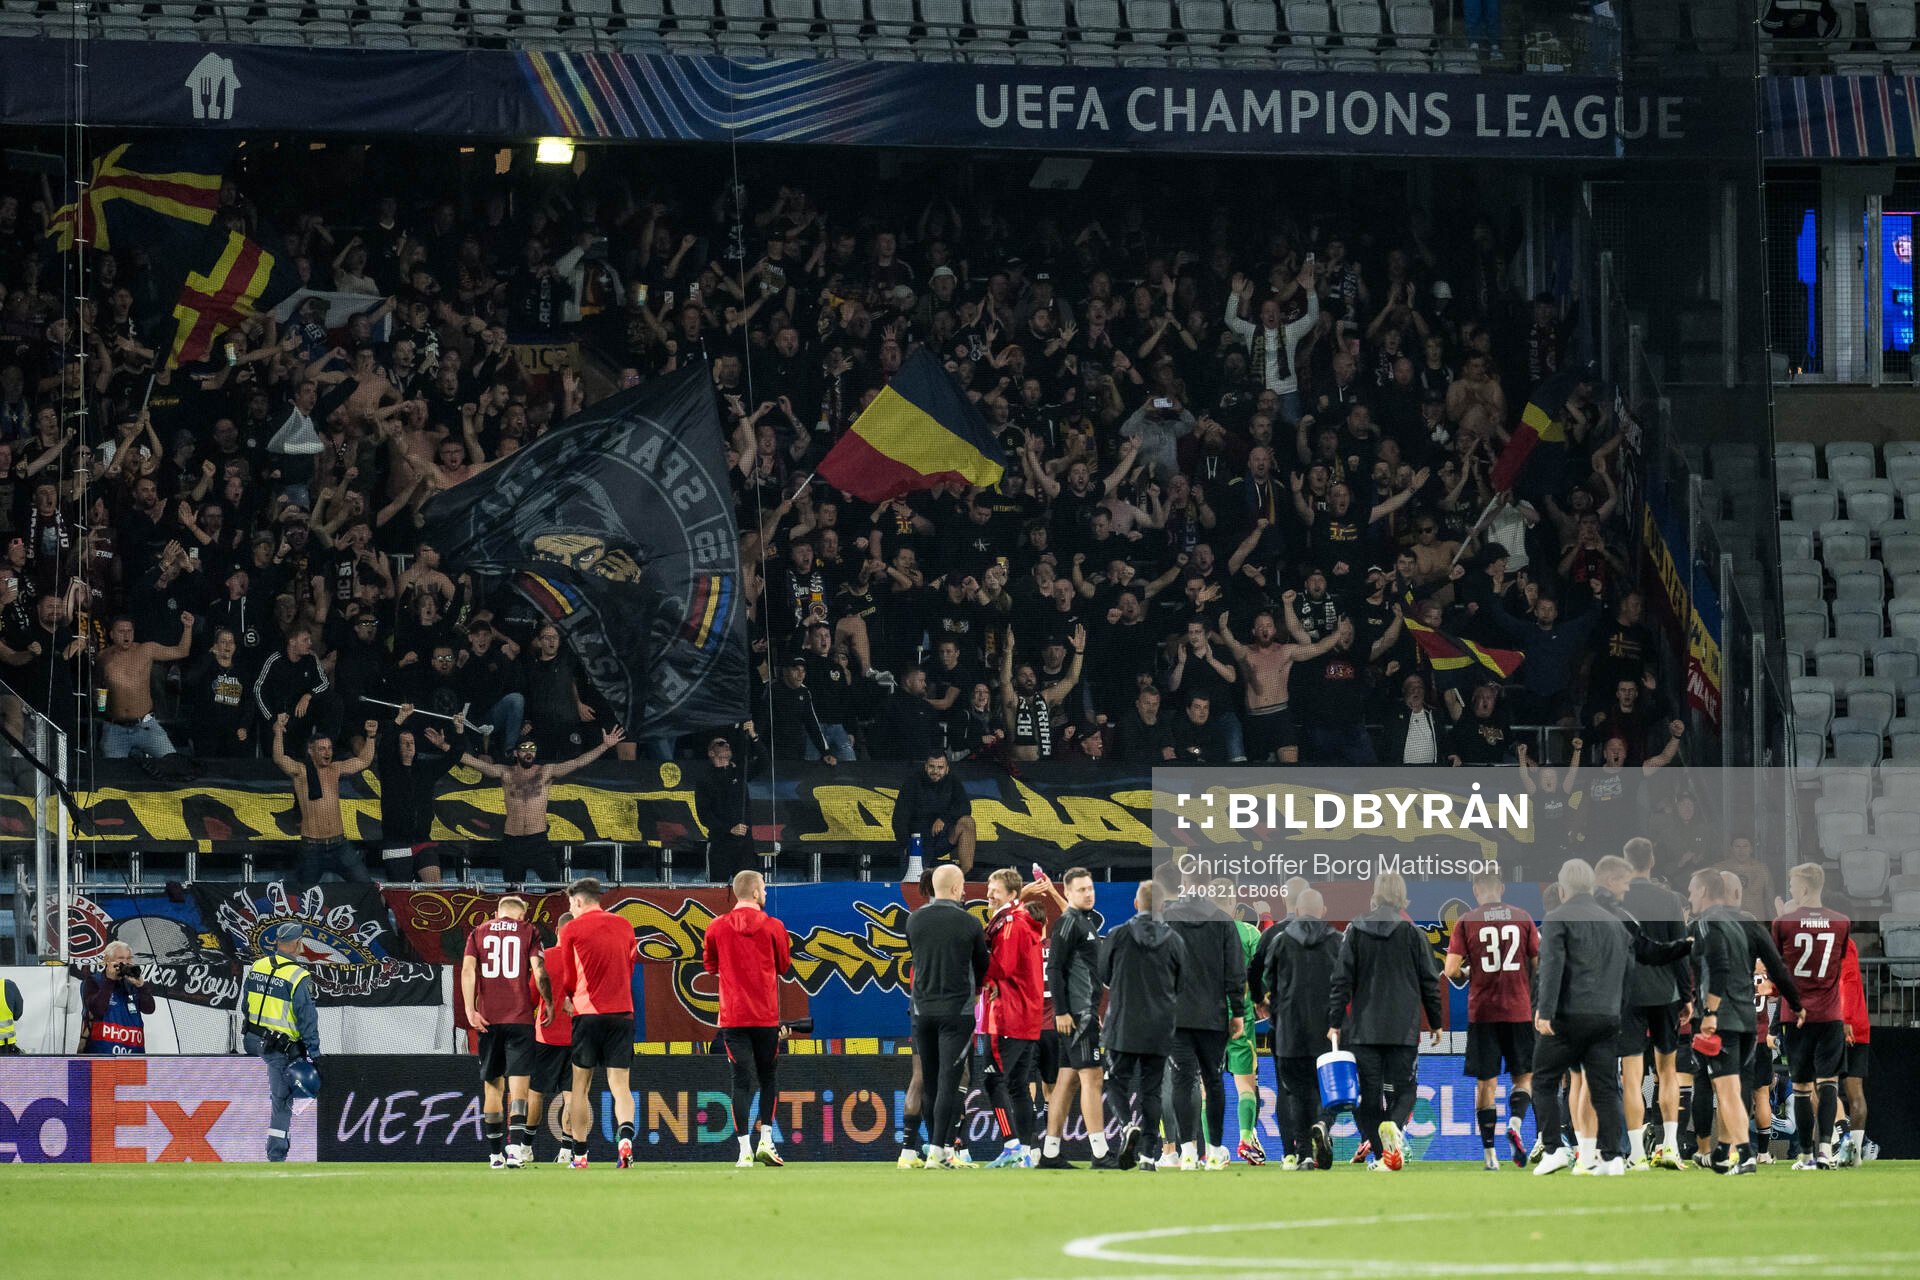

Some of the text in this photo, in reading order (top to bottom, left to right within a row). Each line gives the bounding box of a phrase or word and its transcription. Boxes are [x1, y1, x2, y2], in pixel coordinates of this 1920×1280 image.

[976, 84, 1687, 140] UEFA CHAMPIONS LEAGUE
[482, 936, 520, 979] 30
[1479, 924, 1520, 972] 32
[1794, 932, 1835, 978] 27
[184, 963, 239, 1006] Boys
[250, 972, 285, 987] ORDNNGS
[256, 983, 274, 995] VAT
[102, 1024, 142, 1044] PHOTO
[0, 1060, 232, 1163] dEx
[337, 1090, 485, 1144] UEFA
